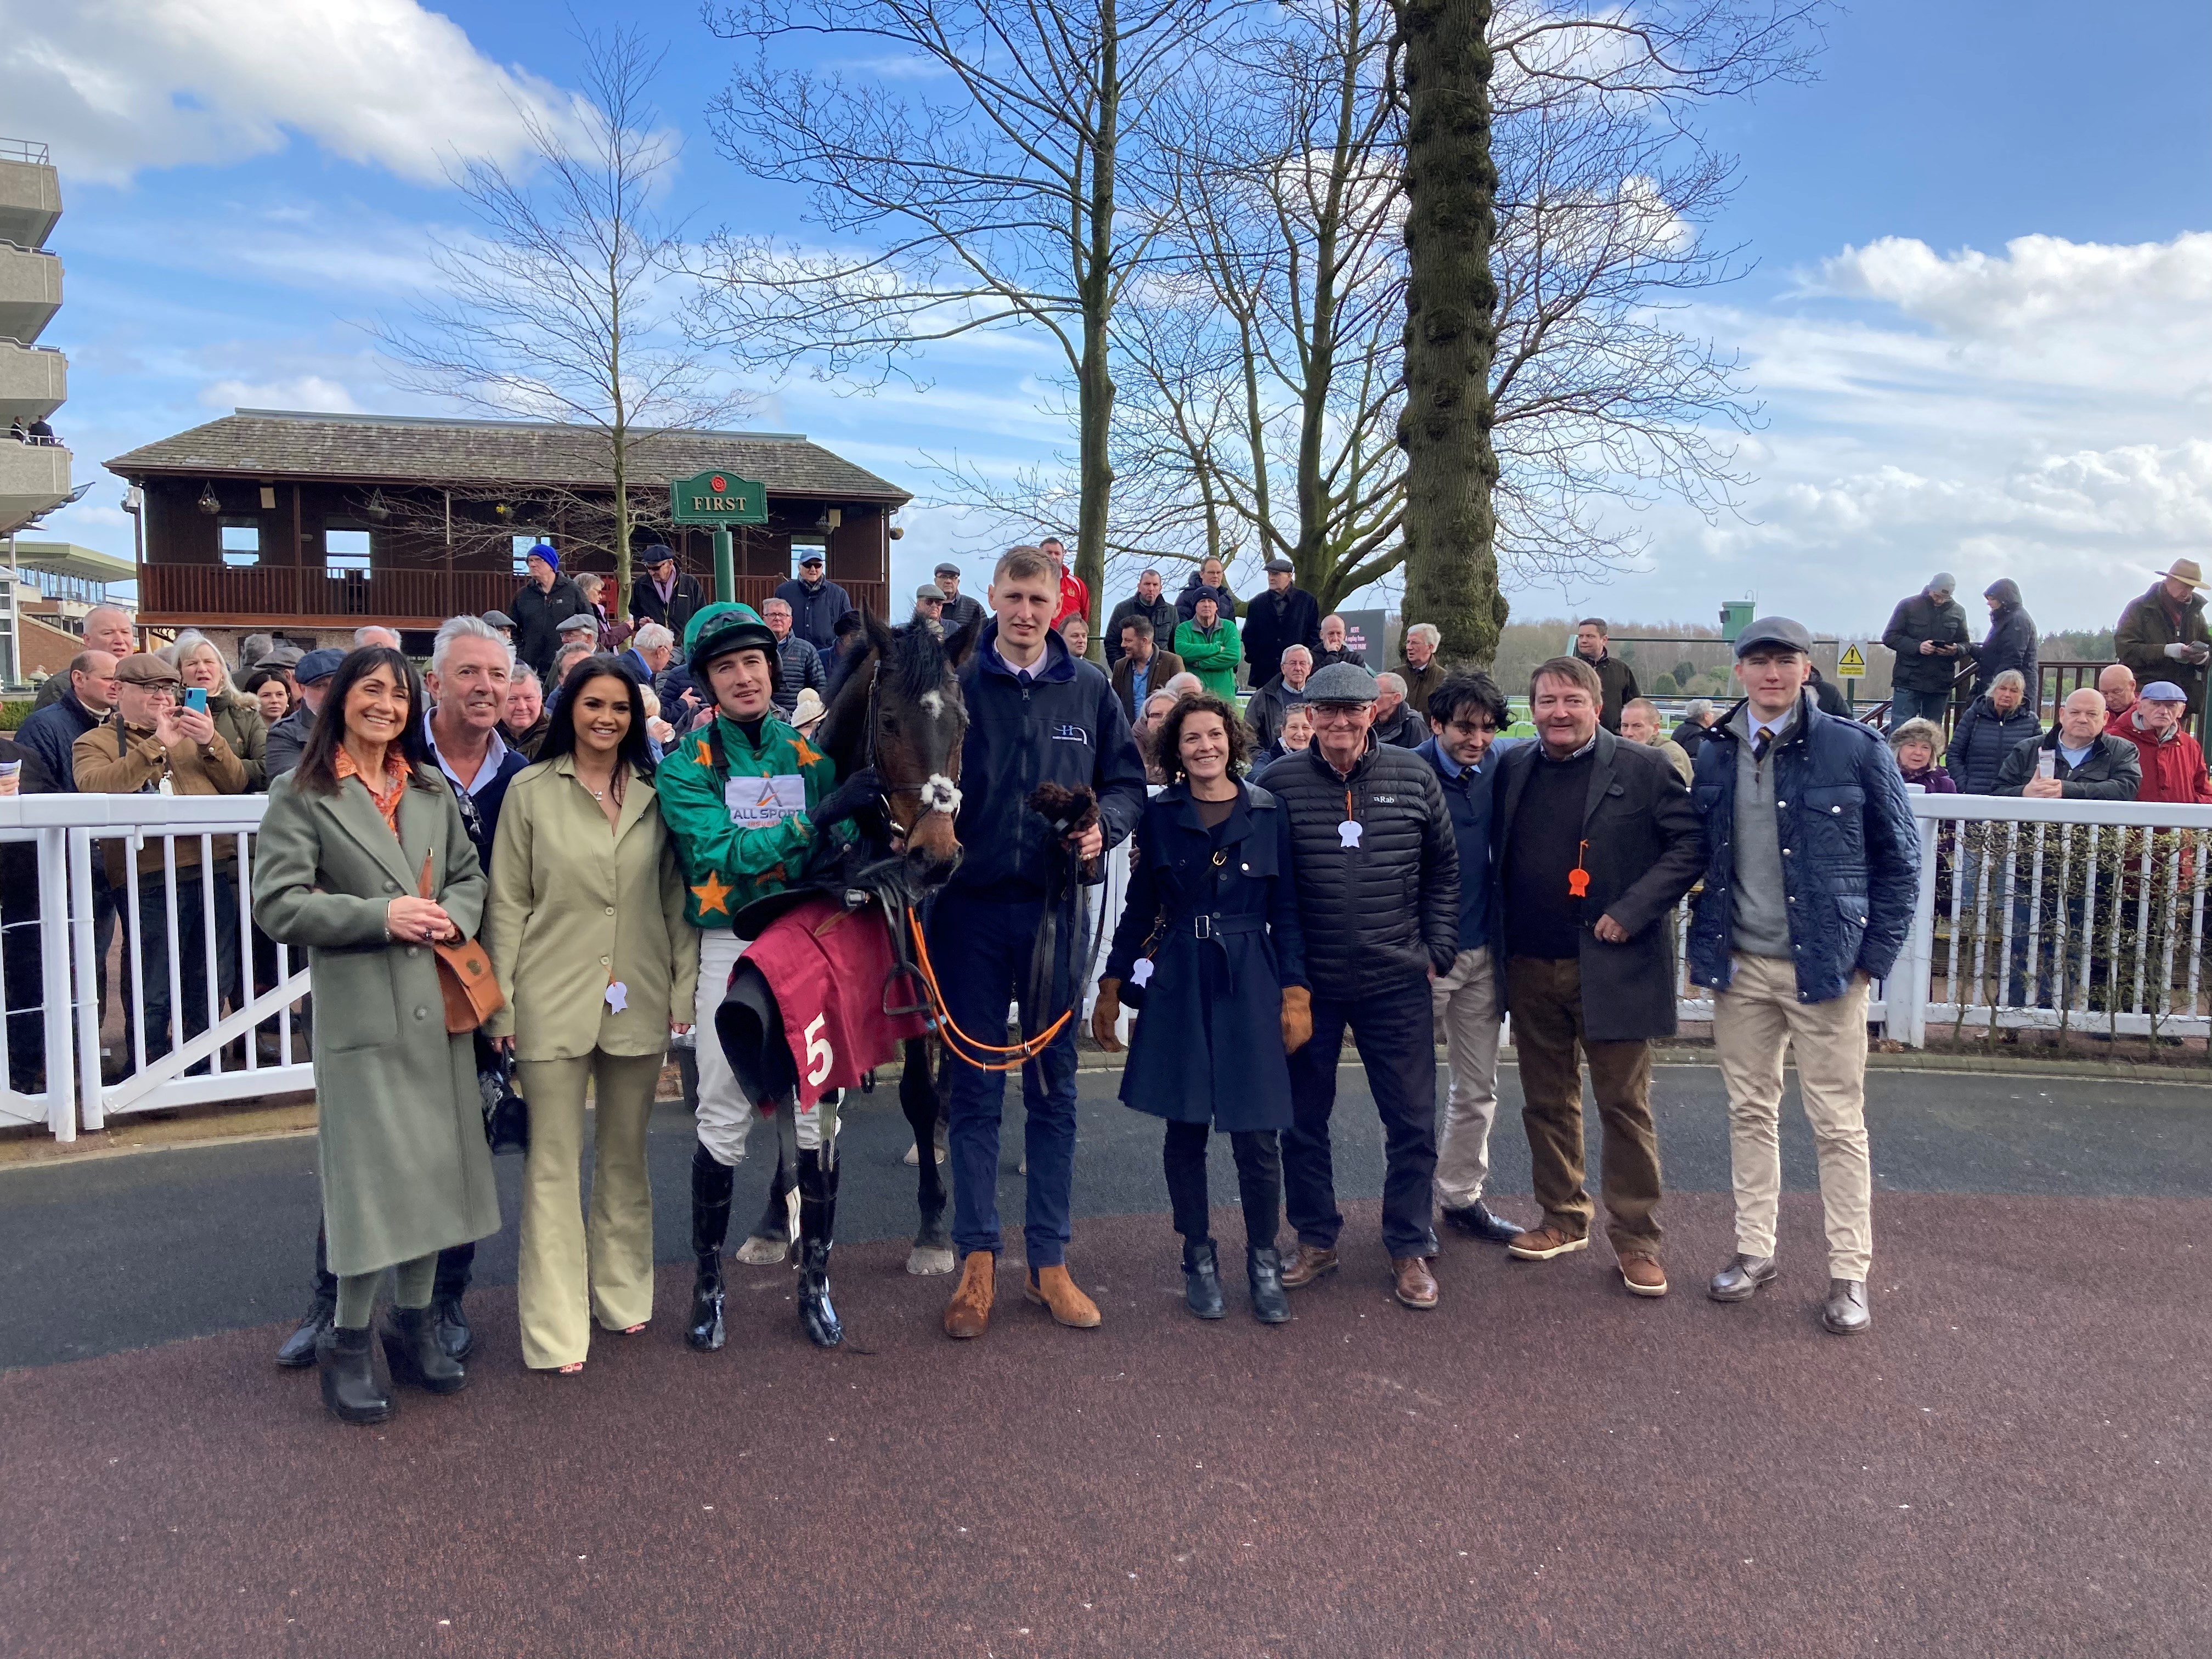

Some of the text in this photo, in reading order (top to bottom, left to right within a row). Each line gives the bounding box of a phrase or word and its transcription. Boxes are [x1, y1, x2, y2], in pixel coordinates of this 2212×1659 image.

[692, 496, 747, 511] FIRST
[733, 809, 758, 819] ALL
[803, 1012, 834, 1087] 5
